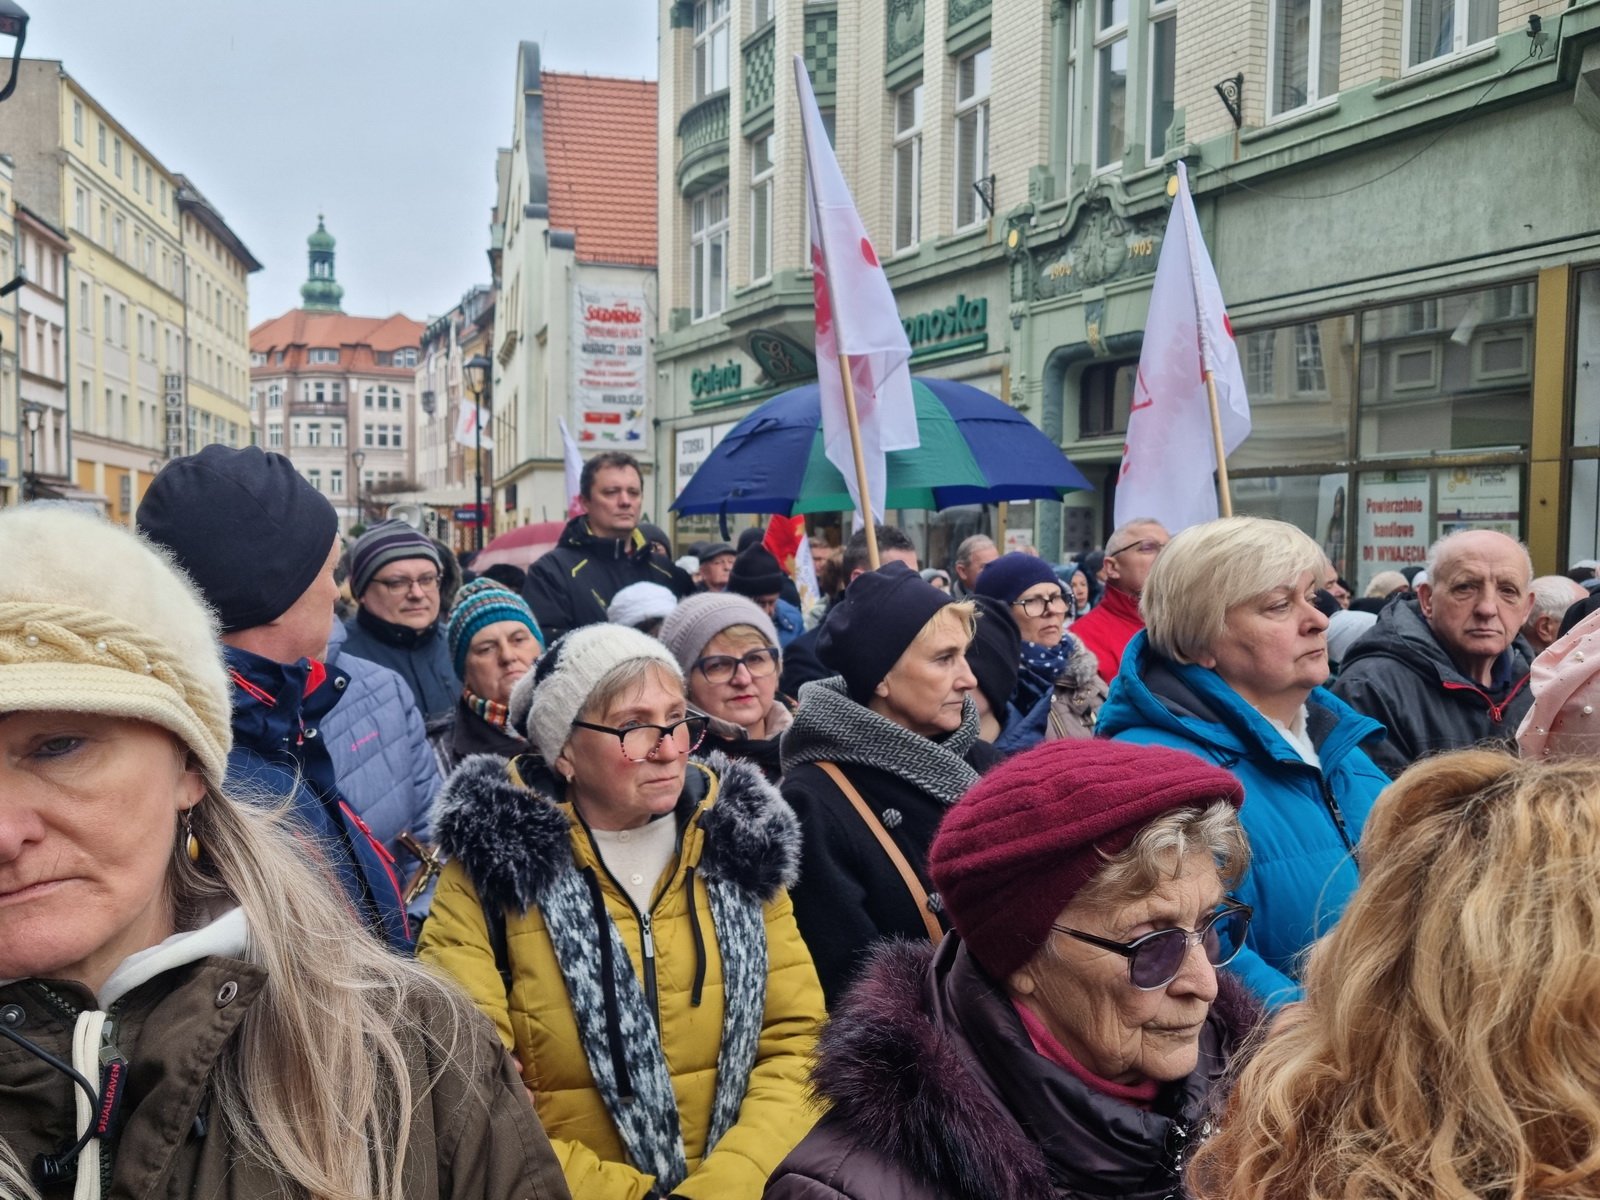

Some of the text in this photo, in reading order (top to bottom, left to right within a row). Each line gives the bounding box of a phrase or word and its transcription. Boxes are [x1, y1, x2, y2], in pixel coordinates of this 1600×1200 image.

[1128, 239, 1153, 259] 1905
[902, 295, 987, 344] onoska
[691, 359, 742, 398] Galeria
[1366, 497, 1423, 514] Powierzchnie
[1374, 521, 1414, 538] handlowe
[1377, 545, 1426, 563] WYNAJĘCIA
